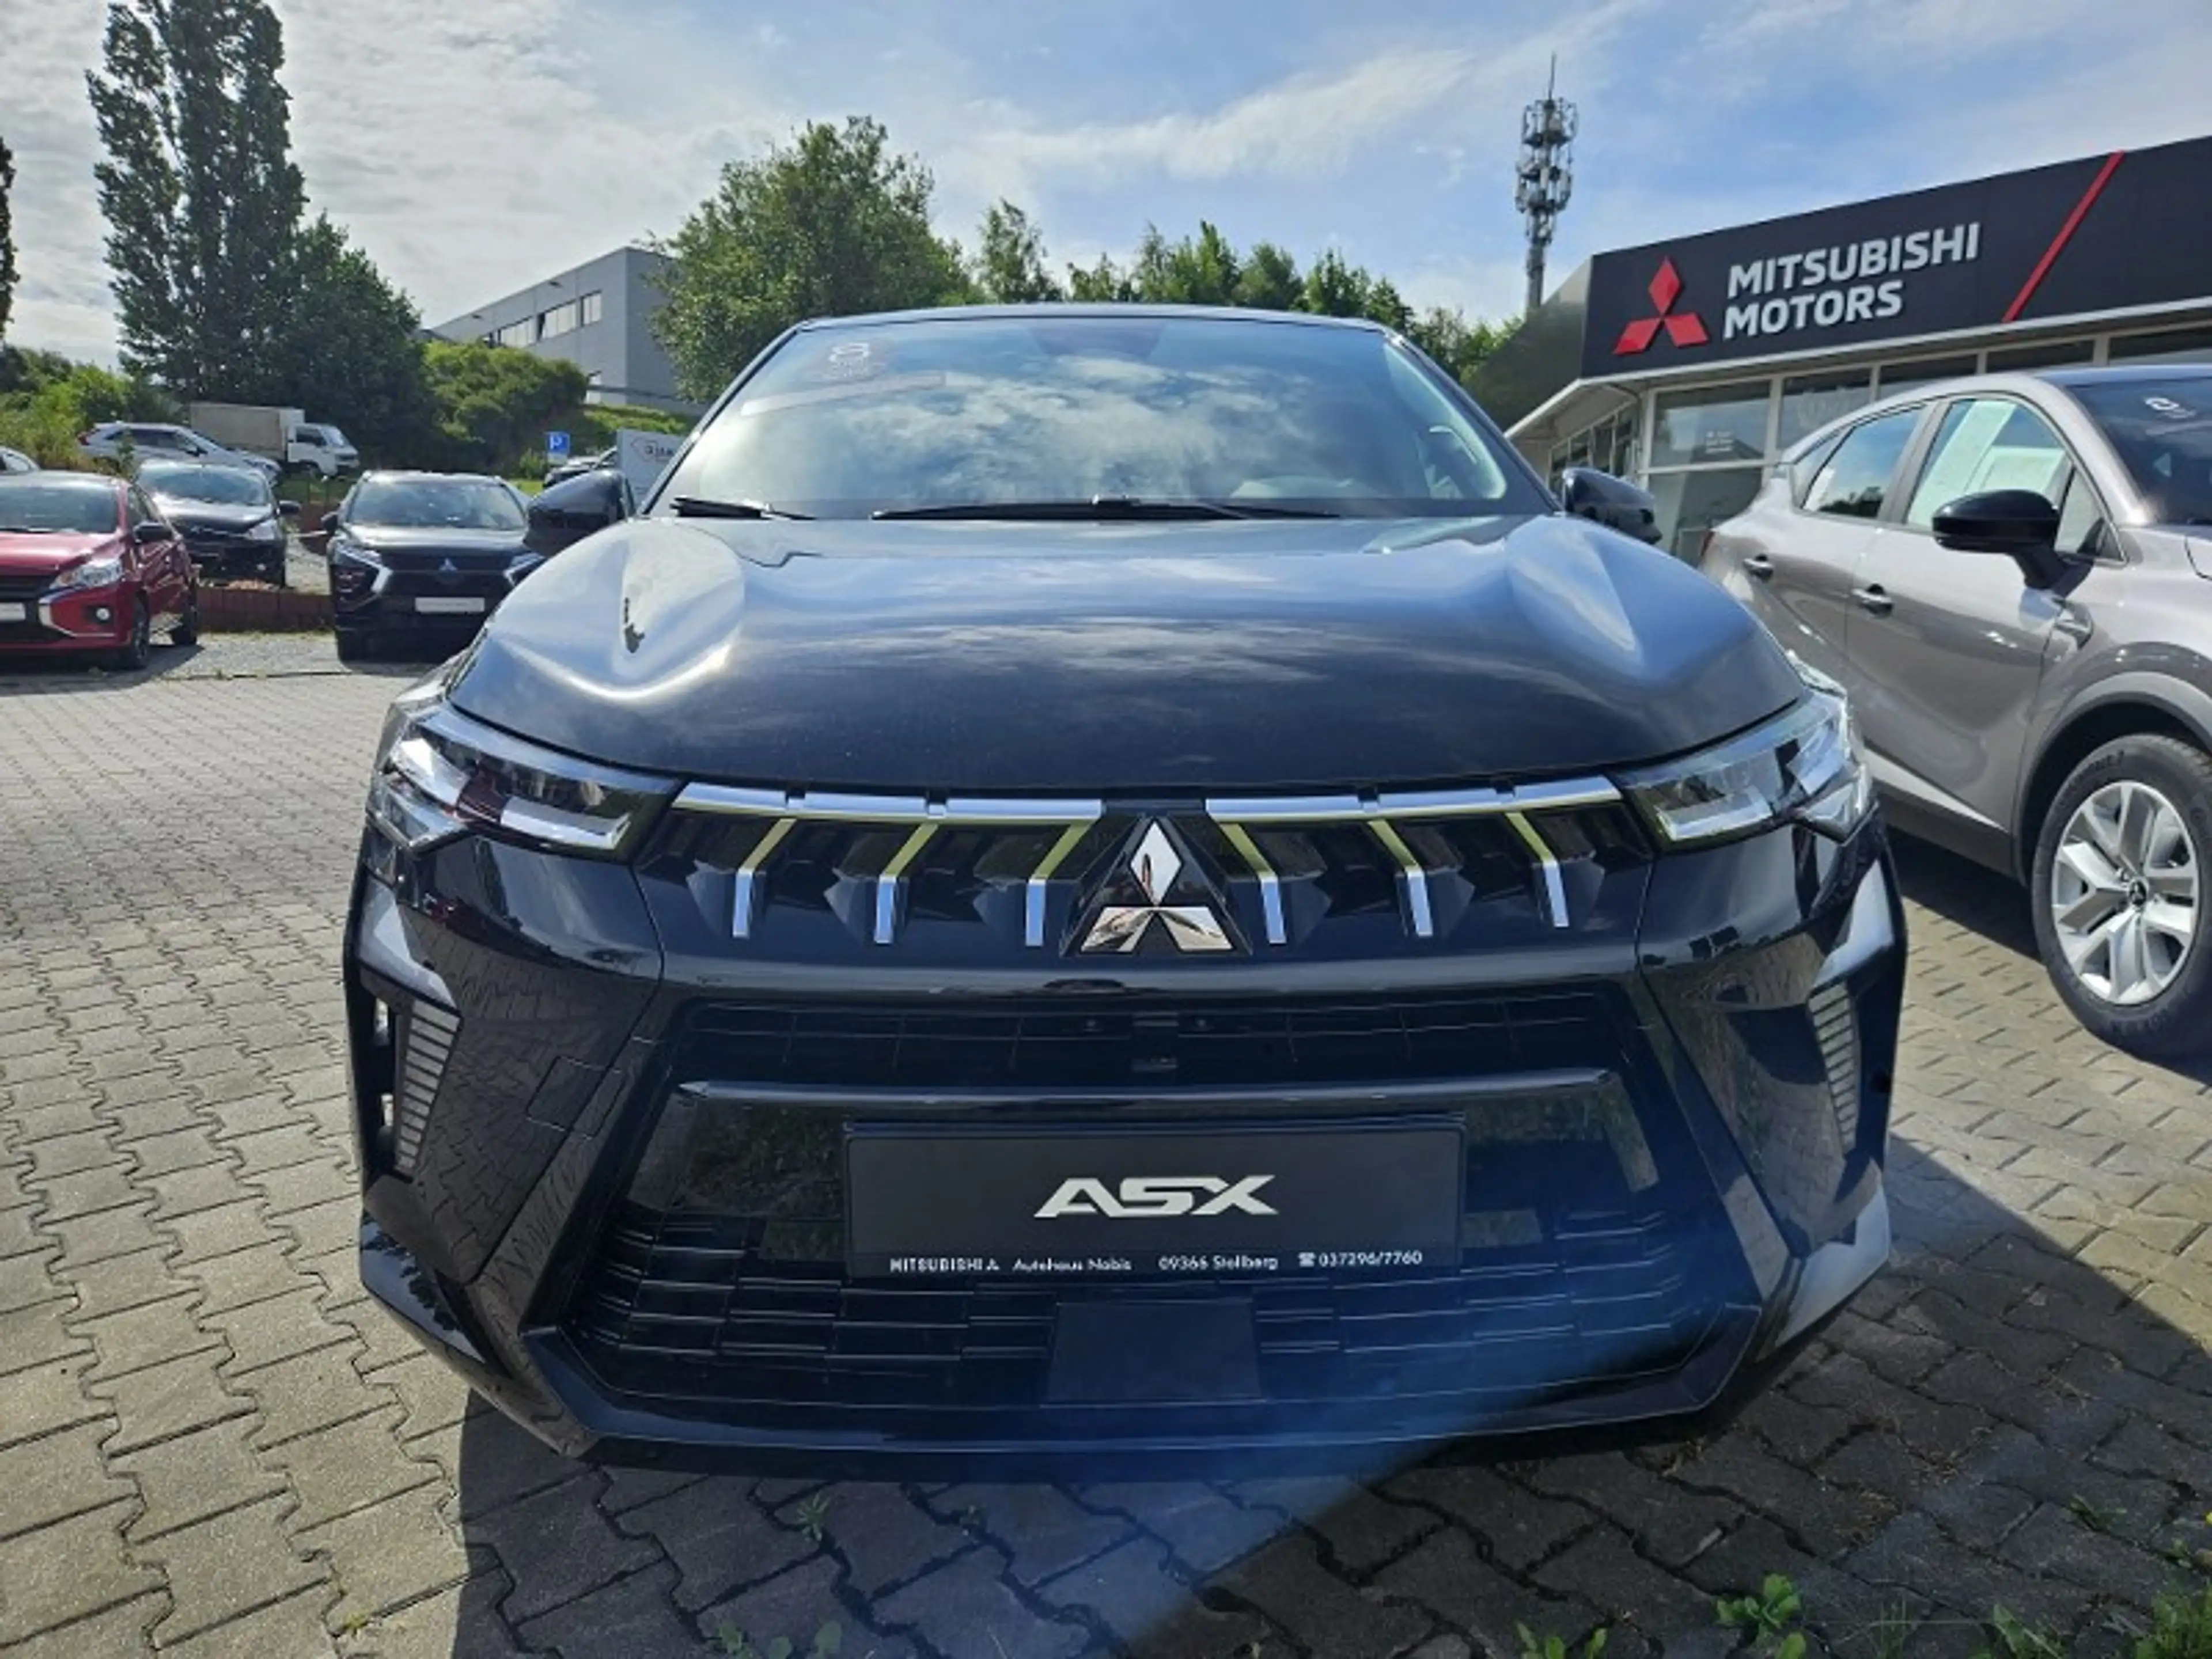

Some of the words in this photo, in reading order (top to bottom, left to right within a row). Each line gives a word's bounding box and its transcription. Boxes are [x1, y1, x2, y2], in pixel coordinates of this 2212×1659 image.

[1728, 222, 1980, 298] MITSUBISHI
[1724, 279, 1903, 339] MOTORS
[550, 436, 562, 449] P
[1033, 1175, 1279, 1218] ASX
[890, 1257, 983, 1272] MITSUBISHI
